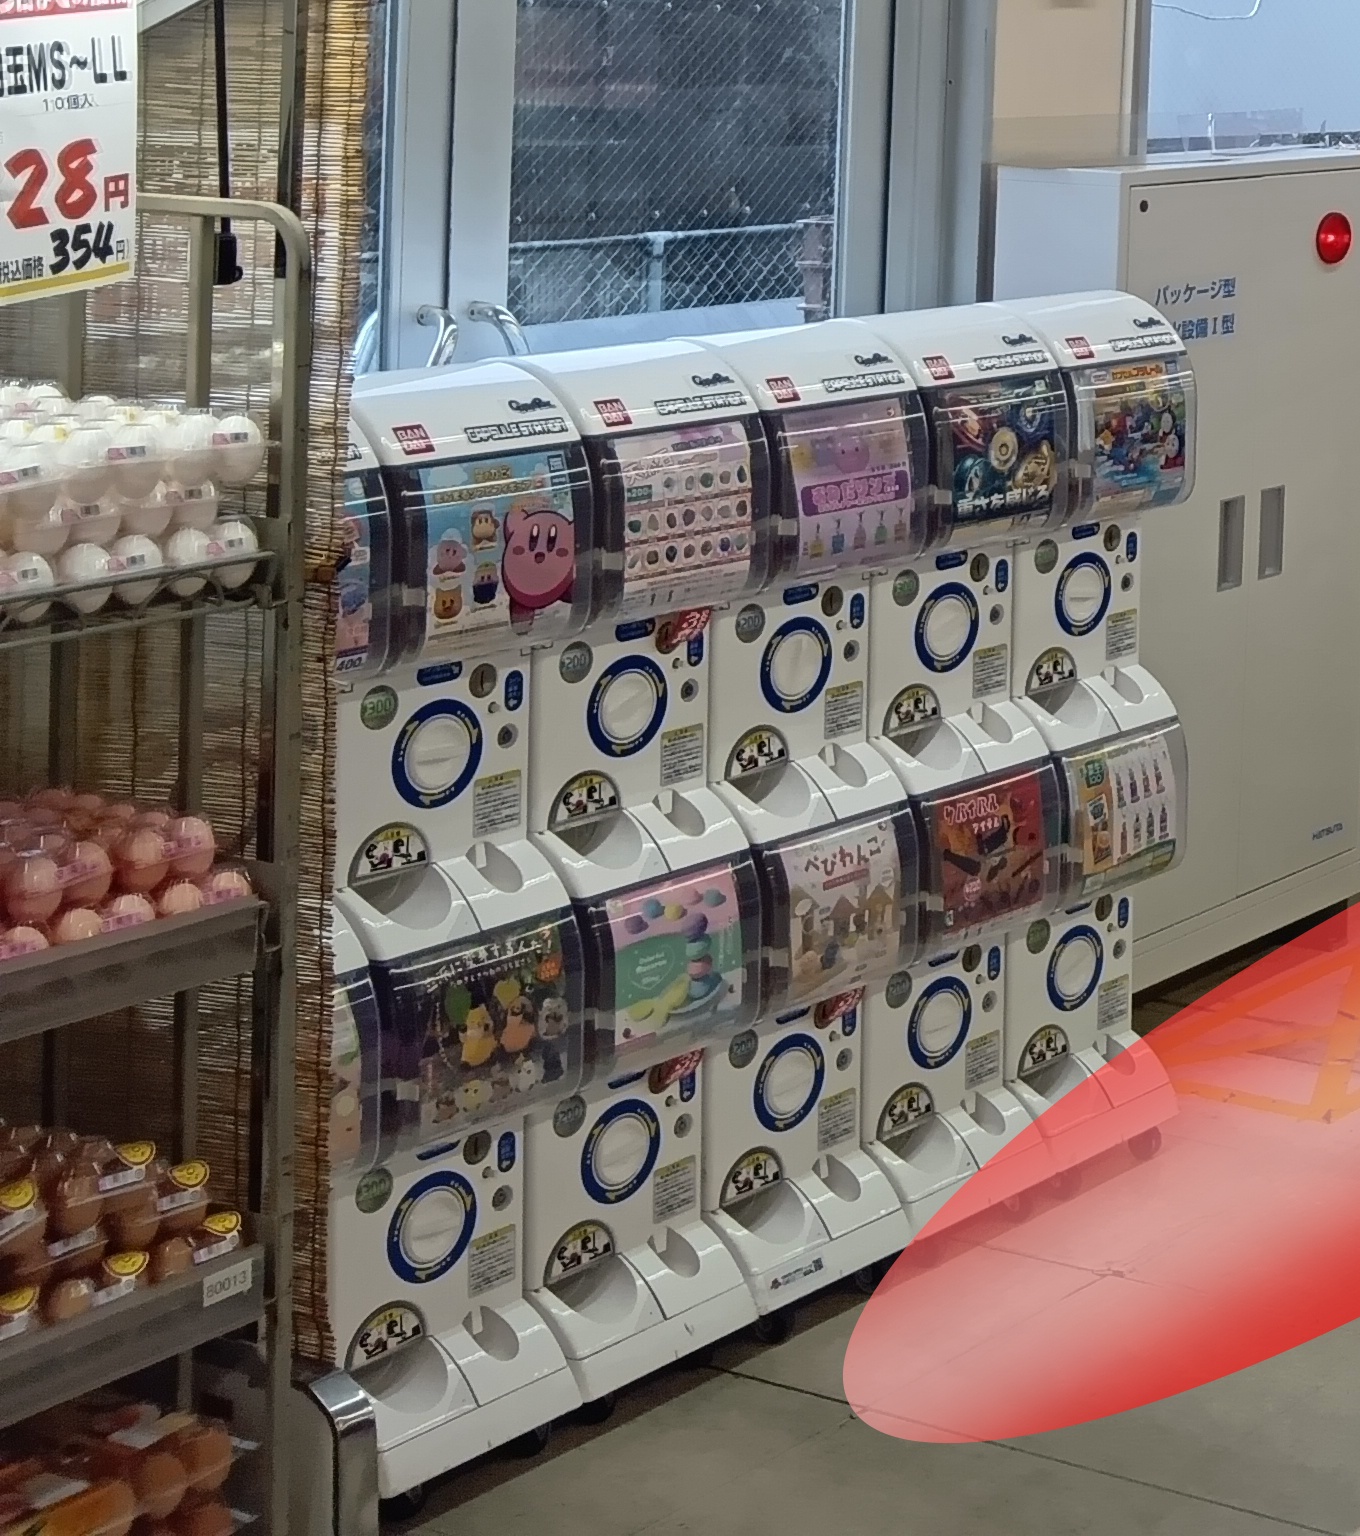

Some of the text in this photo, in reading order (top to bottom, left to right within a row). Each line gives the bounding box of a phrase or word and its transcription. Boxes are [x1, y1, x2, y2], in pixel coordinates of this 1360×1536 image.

[42, 94, 95, 111] 10個入
[1155, 277, 1235, 305] パッケージ型
[206, 1271, 247, 1298] 80013
